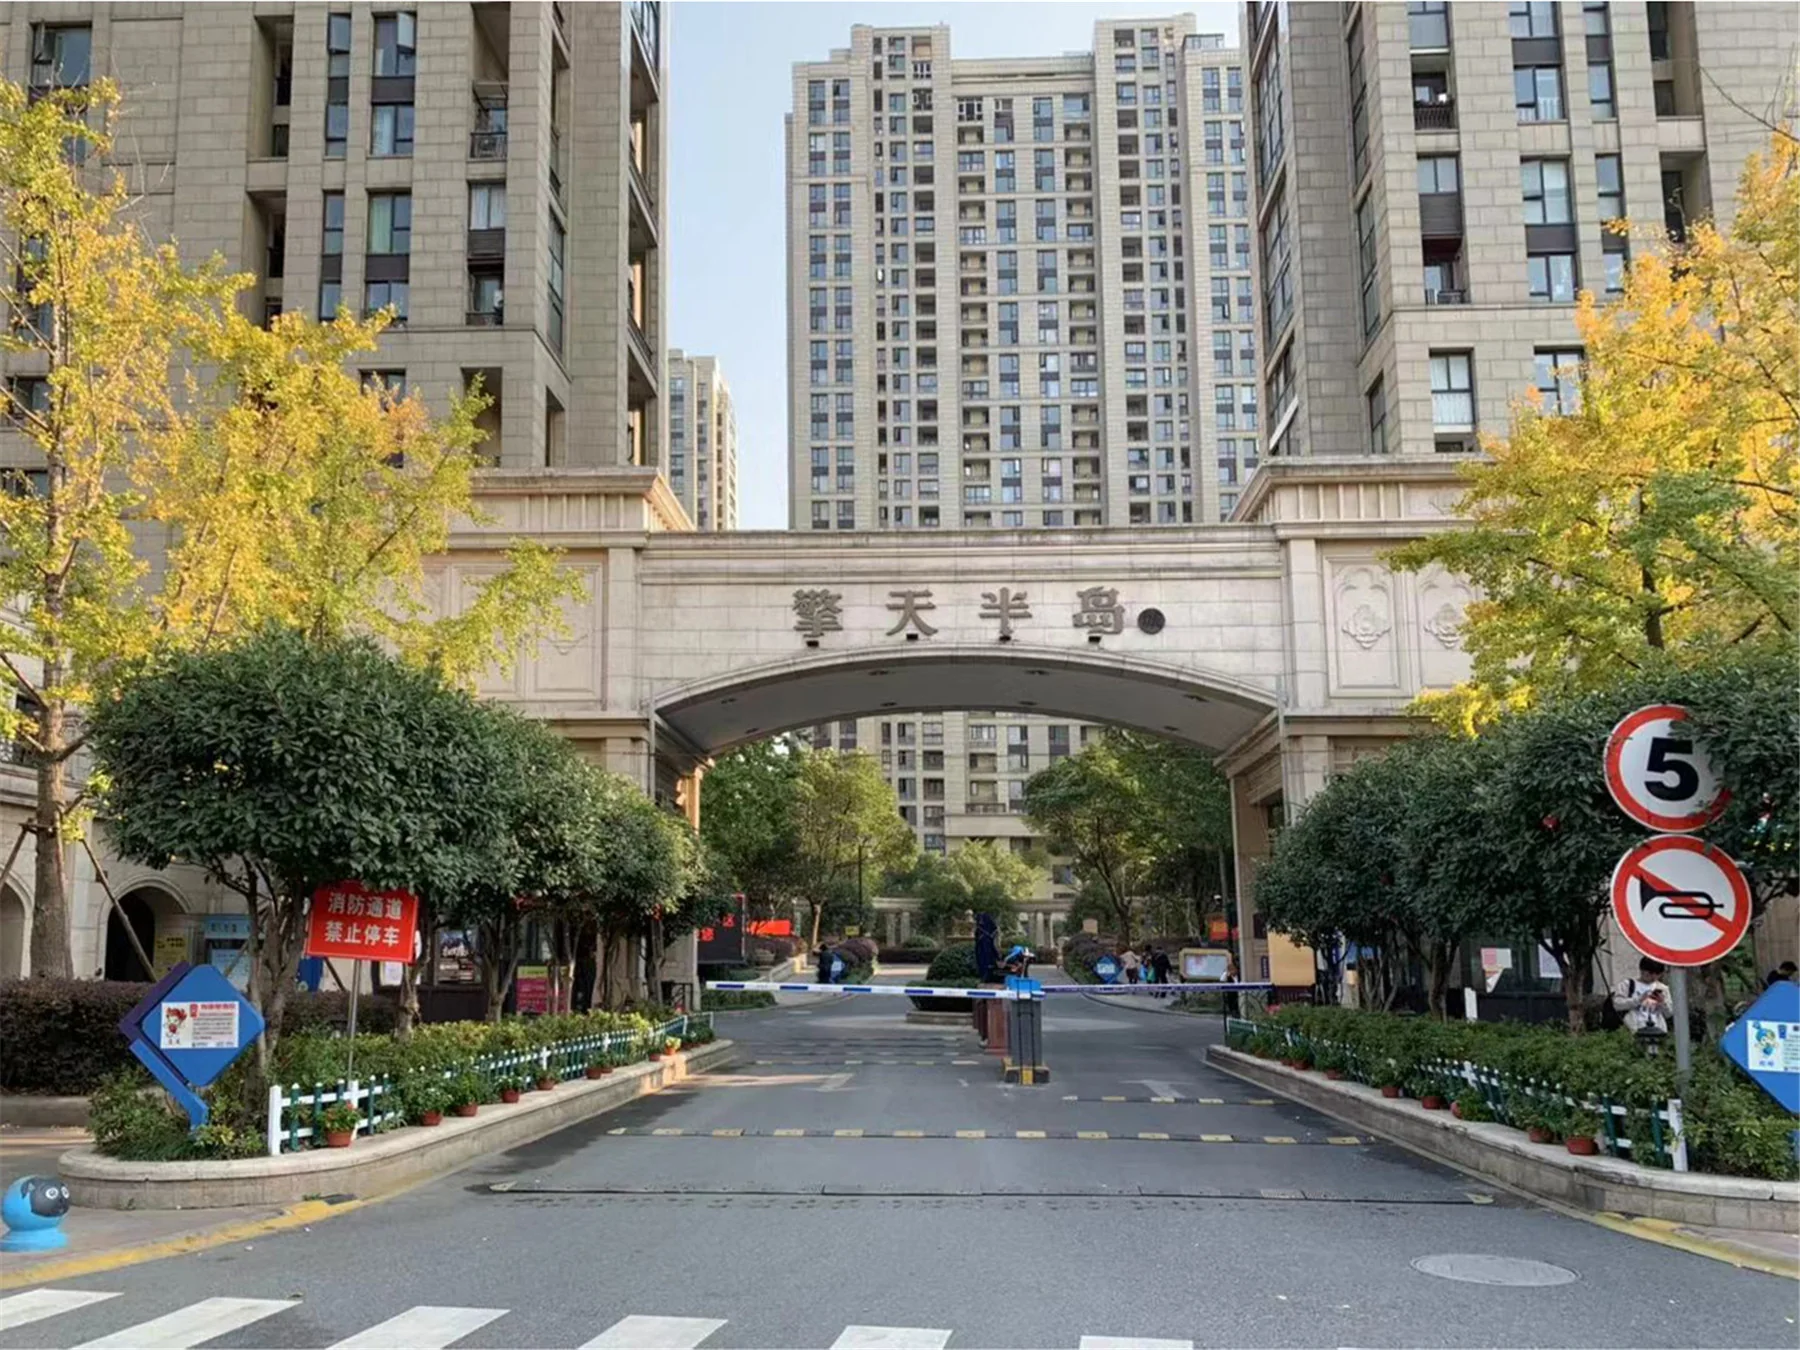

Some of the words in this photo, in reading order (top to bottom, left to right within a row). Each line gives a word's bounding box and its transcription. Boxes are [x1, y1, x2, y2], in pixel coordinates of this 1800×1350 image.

[792, 586, 1125, 637] 擎天半岛
[1644, 736, 1699, 802] 5
[328, 892, 403, 919] 消防通道
[325, 921, 400, 947] 禁止停车
